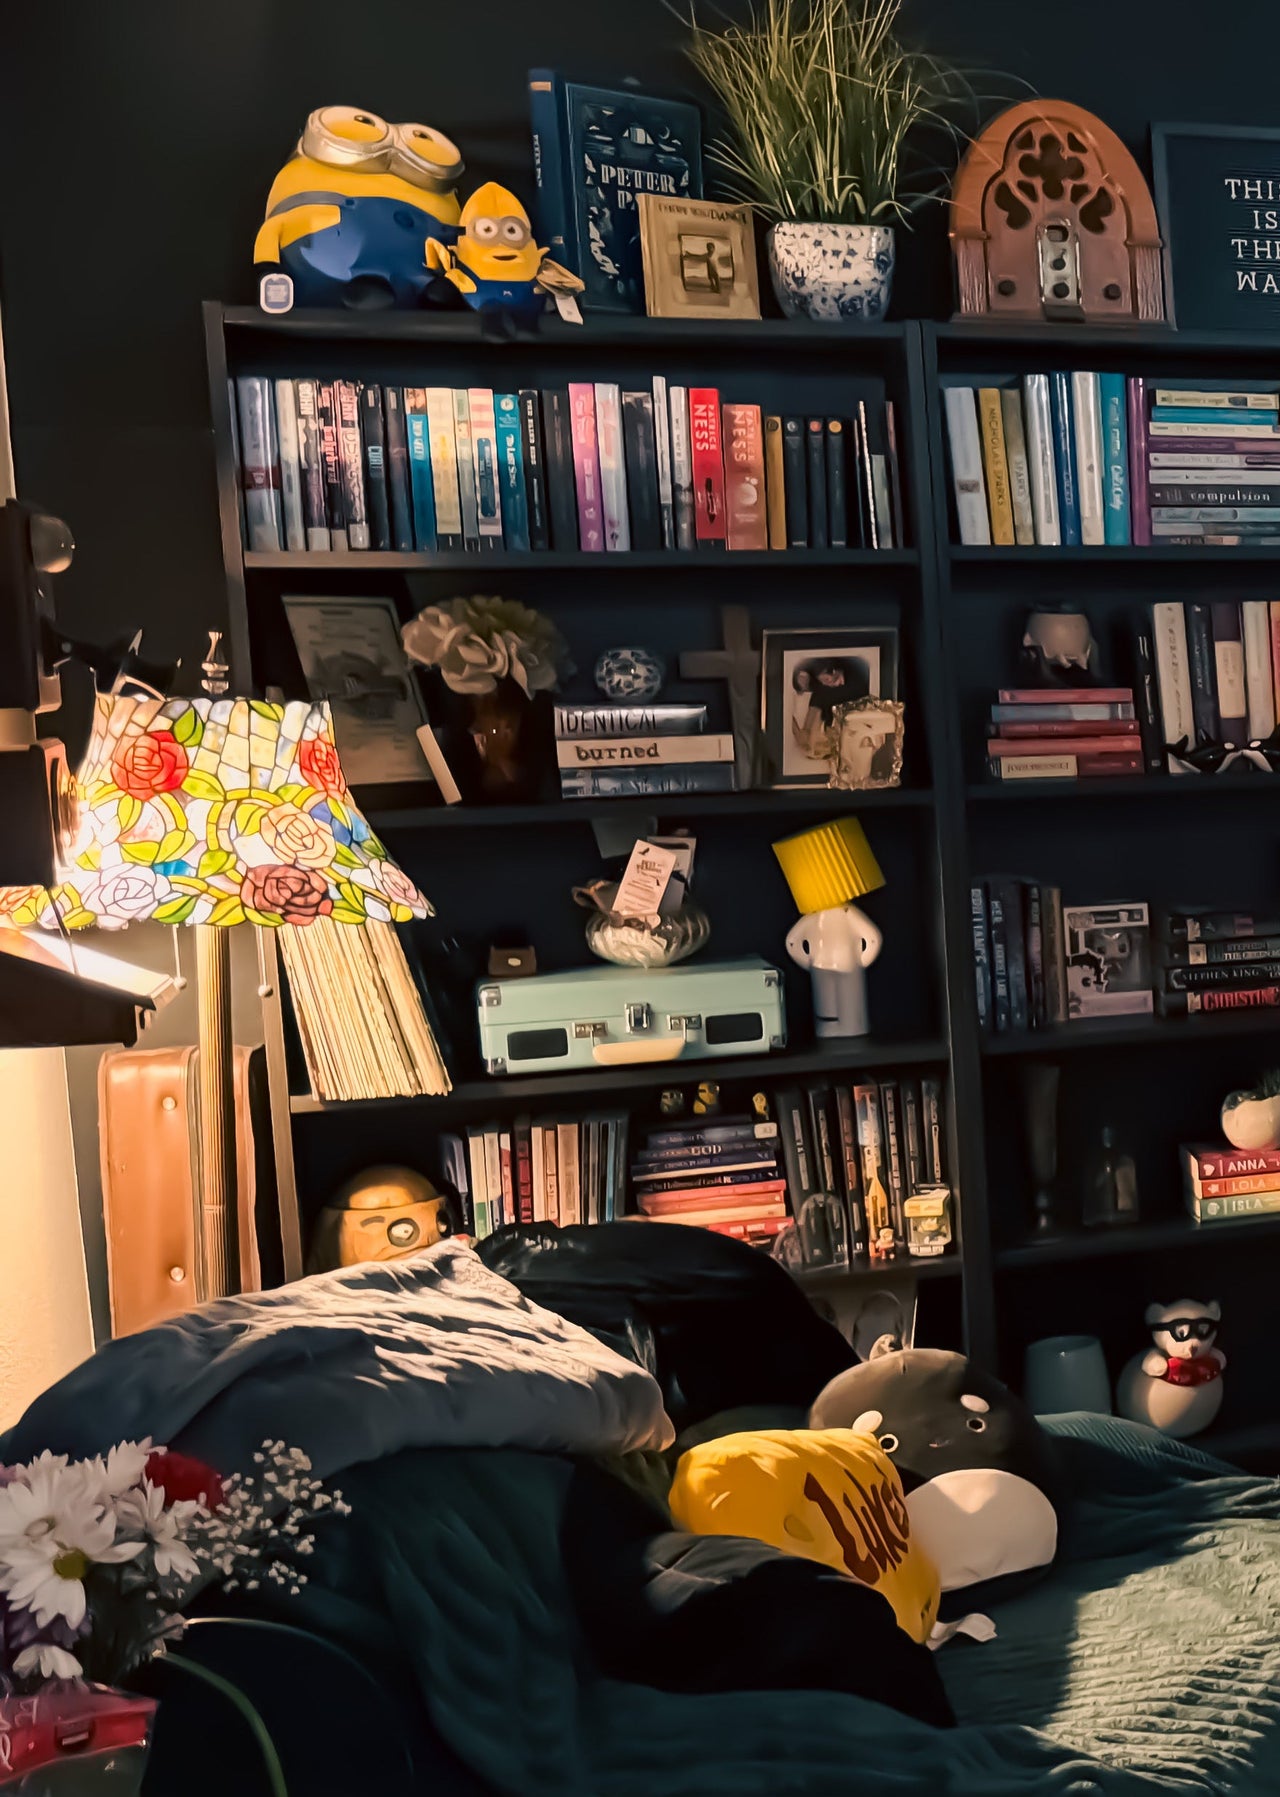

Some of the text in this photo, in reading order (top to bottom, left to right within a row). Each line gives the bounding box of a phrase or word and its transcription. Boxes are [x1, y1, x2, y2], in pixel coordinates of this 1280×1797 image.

[600, 163, 677, 194] PETER
[1254, 211, 1278, 230] IS
[693, 404, 709, 451] NESS
[731, 411, 748, 463] NESS
[1190, 489, 1271, 503] compulsion
[576, 743, 659, 761] burned
[1228, 1159, 1267, 1173] ANNA
[1232, 1182, 1267, 1193] LOLA
[1232, 1198, 1264, 1213] ISLA
